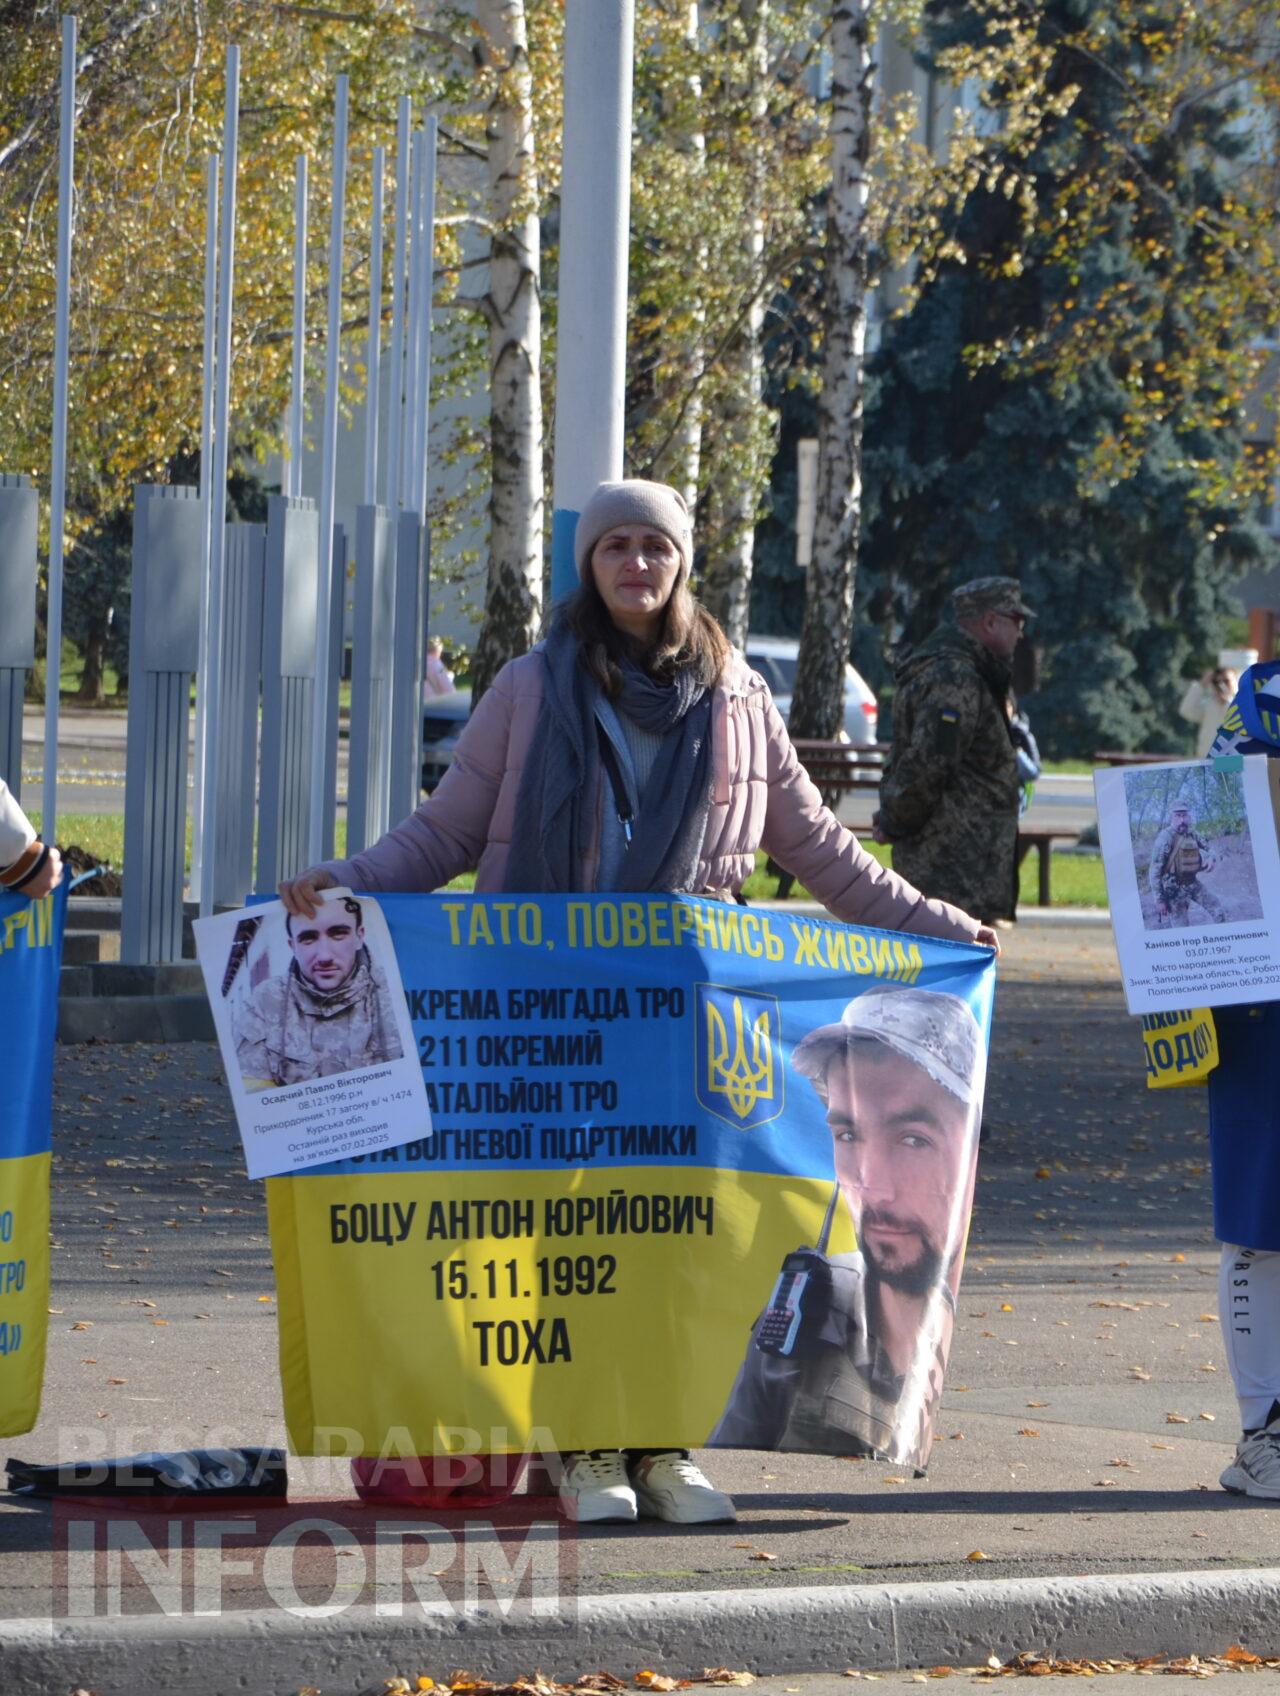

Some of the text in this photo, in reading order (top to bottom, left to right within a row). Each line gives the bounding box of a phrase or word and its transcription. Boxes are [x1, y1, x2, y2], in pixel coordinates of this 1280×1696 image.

[442, 901, 923, 984] ТАТО, ПОВЕРНИСЬ ЖИВИМ
[1145, 931, 1269, 950] Ханіков Ігор Валентинович
[1185, 946, 1232, 958] 03.07.1967
[1152, 953, 1271, 973] Місто народження: Херсон
[1154, 973, 1204, 986] Запорізька
[1205, 968, 1243, 980] область,
[404, 987, 685, 1022] КРЕМА БРИГАДА ТРО
[1148, 984, 1209, 997] Пологівський
[1210, 981, 1238, 992] район
[419, 1029, 602, 1067] 211 ОКРЕМИЙ
[261, 1069, 392, 1106] Осадчий Павло Вікторович
[298, 1092, 347, 1111] 08.12.1996
[569, 1080, 617, 1112] ТРО
[254, 1111, 325, 1135] Прикордонник
[326, 1107, 336, 1117] 17
[339, 1101, 369, 1115] загону
[391, 1089, 412, 1102] 1474
[306, 1113, 366, 1136] Курська обл.
[288, 1122, 388, 1153] Останній раз виходив
[294, 1153, 305, 1163] на
[341, 1134, 390, 1151] 07.02.2025
[541, 1125, 697, 1162] ПІДРТИМКИ
[330, 1190, 714, 1246] БОЦУ АНТОН ЮРІЙОВИЧ
[431, 1255, 617, 1300] 15.11.1992
[473, 1317, 572, 1366] ТОХА
